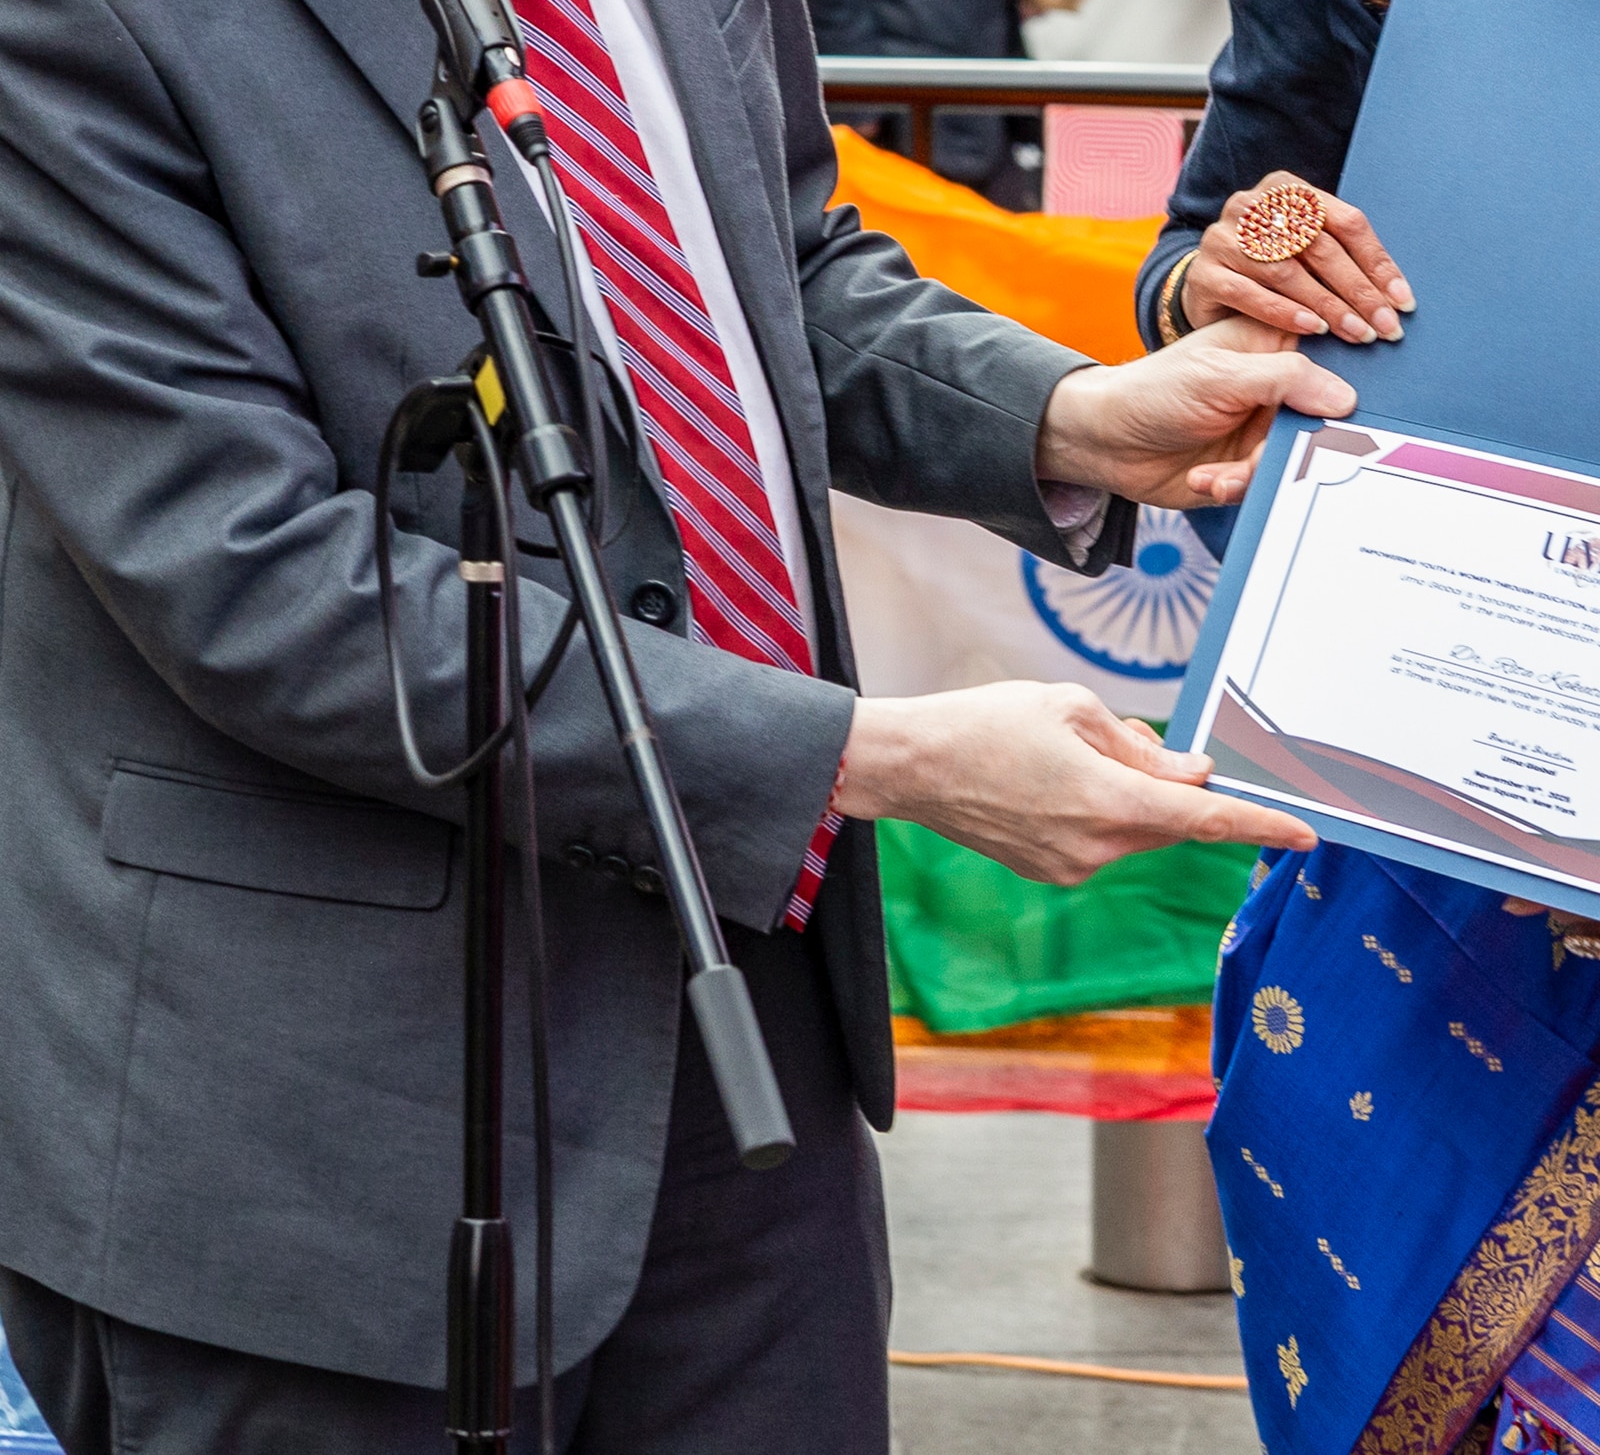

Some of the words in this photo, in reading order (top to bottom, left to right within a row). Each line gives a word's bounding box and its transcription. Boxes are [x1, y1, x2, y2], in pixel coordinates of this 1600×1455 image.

[1459, 572, 1491, 584] WOMEN
[1537, 624, 1595, 644] dedication
[1439, 668, 1495, 688] Committee
